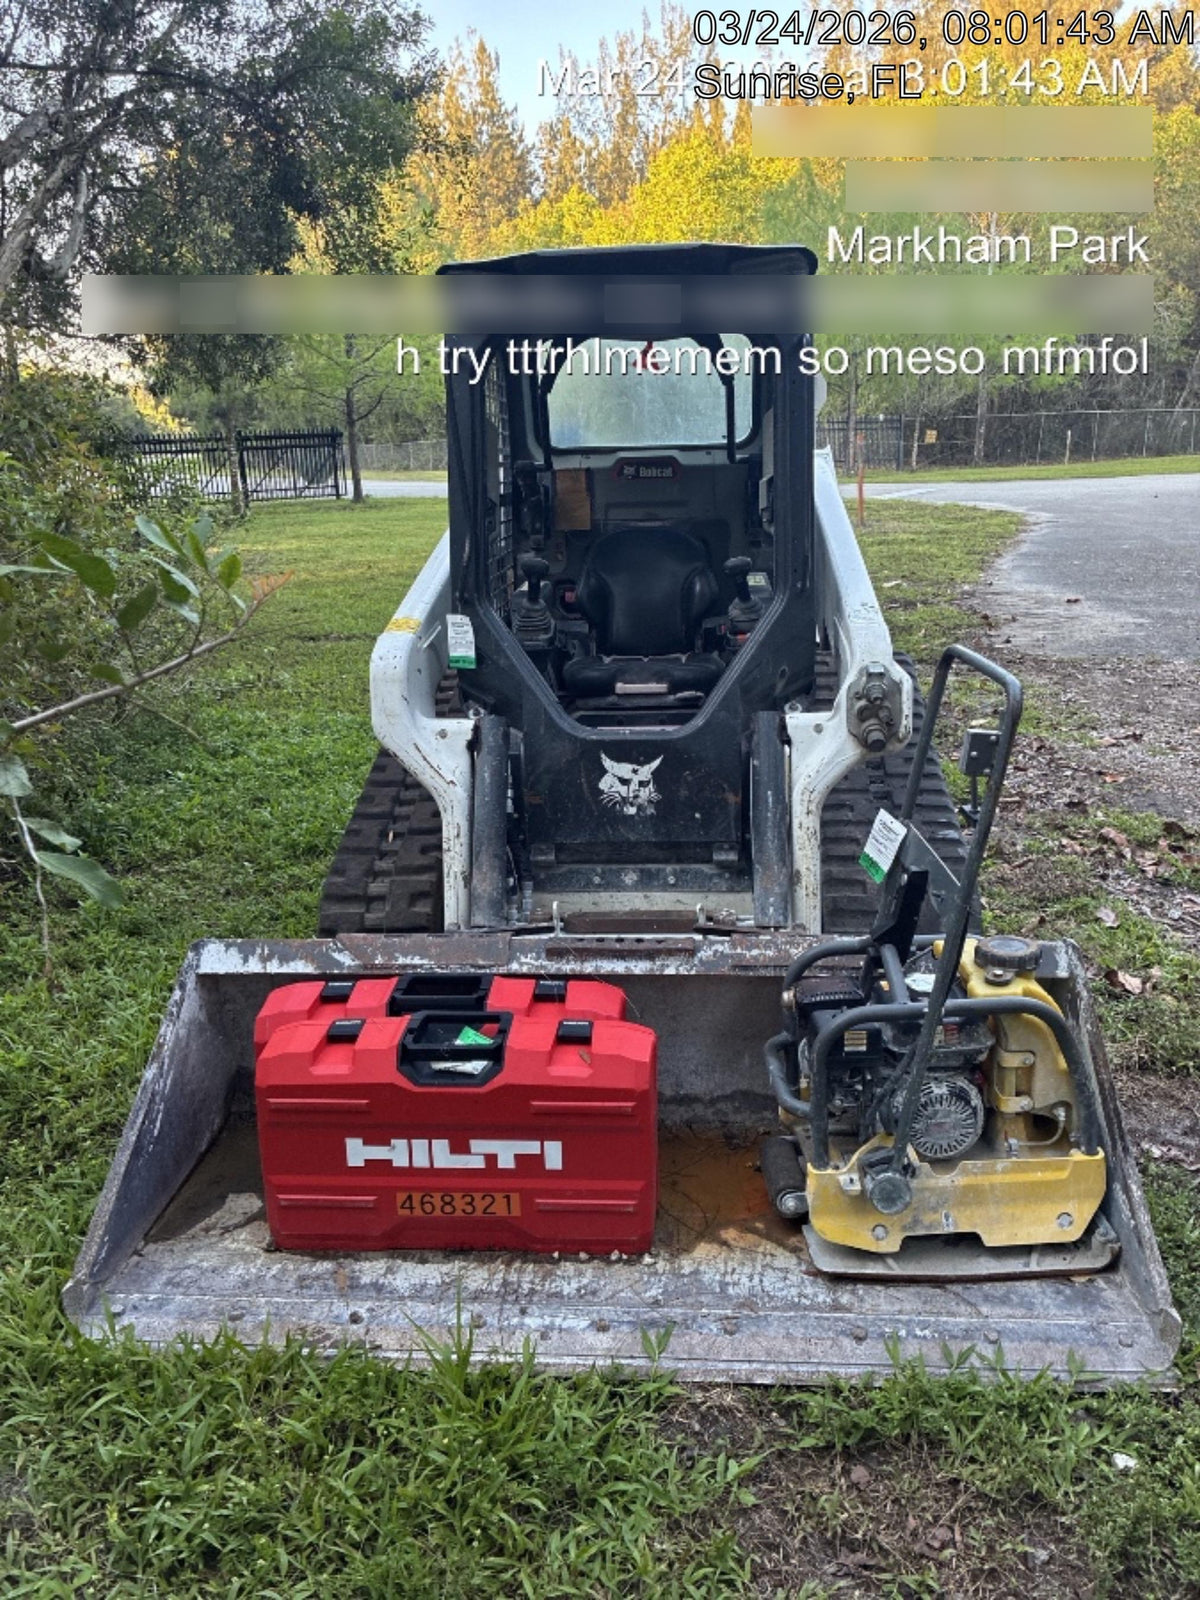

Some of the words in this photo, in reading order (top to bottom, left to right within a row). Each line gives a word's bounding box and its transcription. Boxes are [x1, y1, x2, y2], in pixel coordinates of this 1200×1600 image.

[639, 465, 673, 478] Bobcat
[345, 1137, 562, 1170] HILTI
[399, 1193, 514, 1216] 468321
